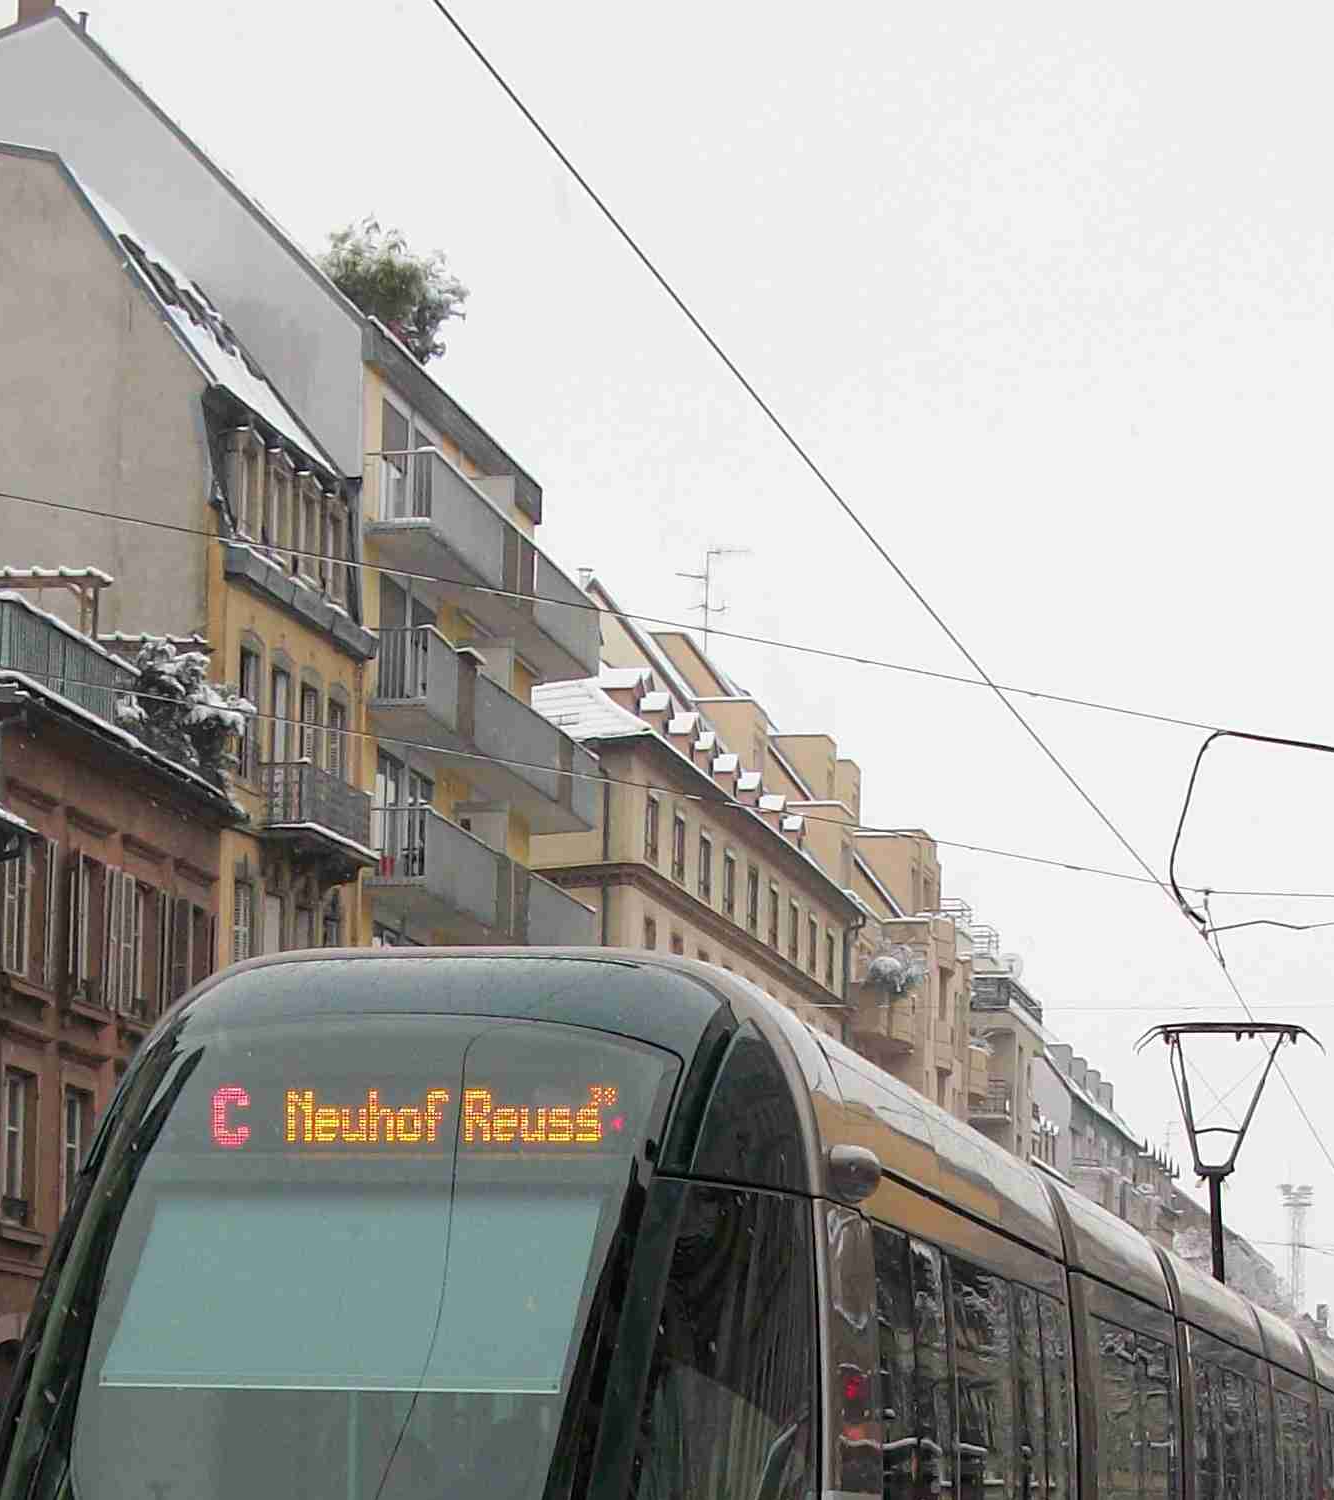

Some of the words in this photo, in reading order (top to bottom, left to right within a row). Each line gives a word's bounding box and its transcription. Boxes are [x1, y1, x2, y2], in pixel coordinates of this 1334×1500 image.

[211, 1086, 251, 1147] C
[284, 1087, 450, 1143] Neuhof
[462, 1087, 602, 1143] Reuss
